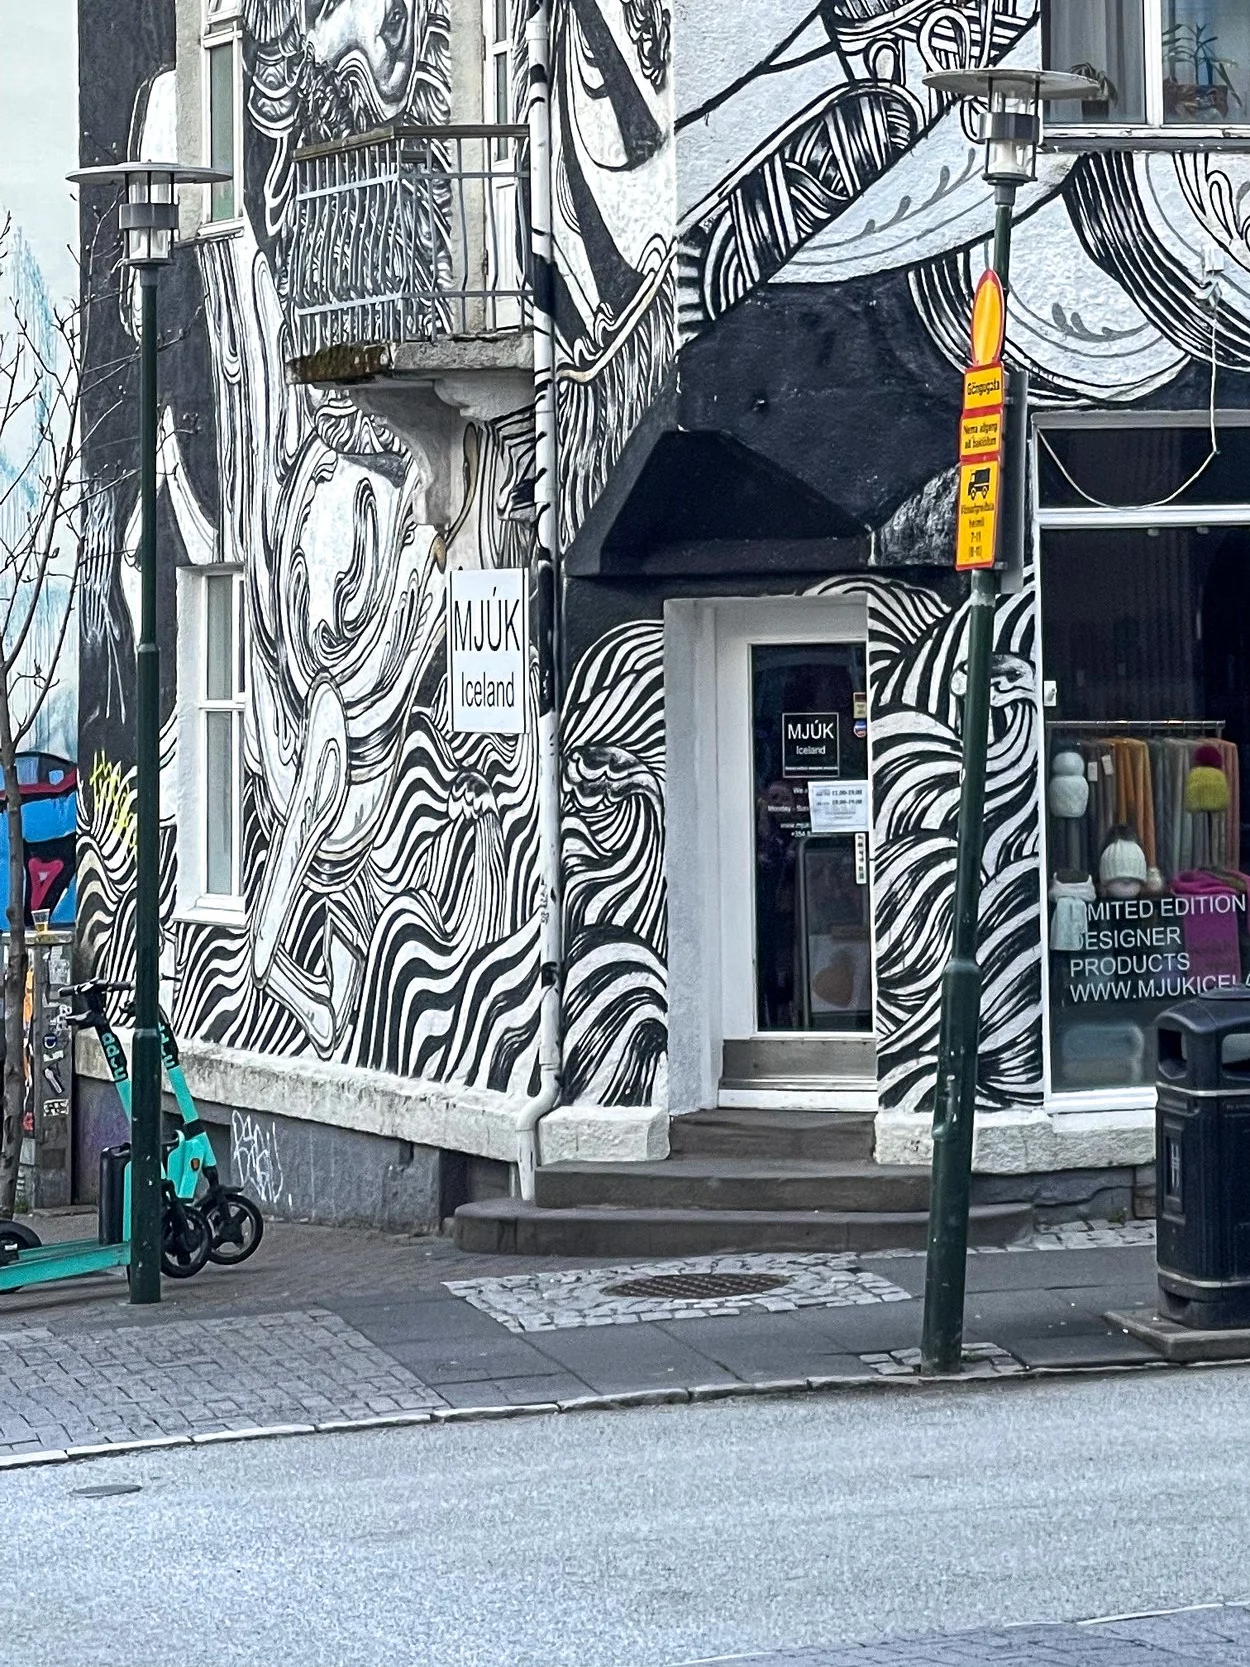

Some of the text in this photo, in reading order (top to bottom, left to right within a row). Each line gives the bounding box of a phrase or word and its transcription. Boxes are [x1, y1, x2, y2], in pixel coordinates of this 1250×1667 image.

[454, 586, 521, 652] MJÚK
[461, 671, 515, 708] Iceland
[787, 719, 834, 740] MJÚK
[796, 745, 826, 755] Iceland
[1082, 894, 1246, 922] MITED EDITION
[1070, 952, 1191, 977] PRODUCTS
